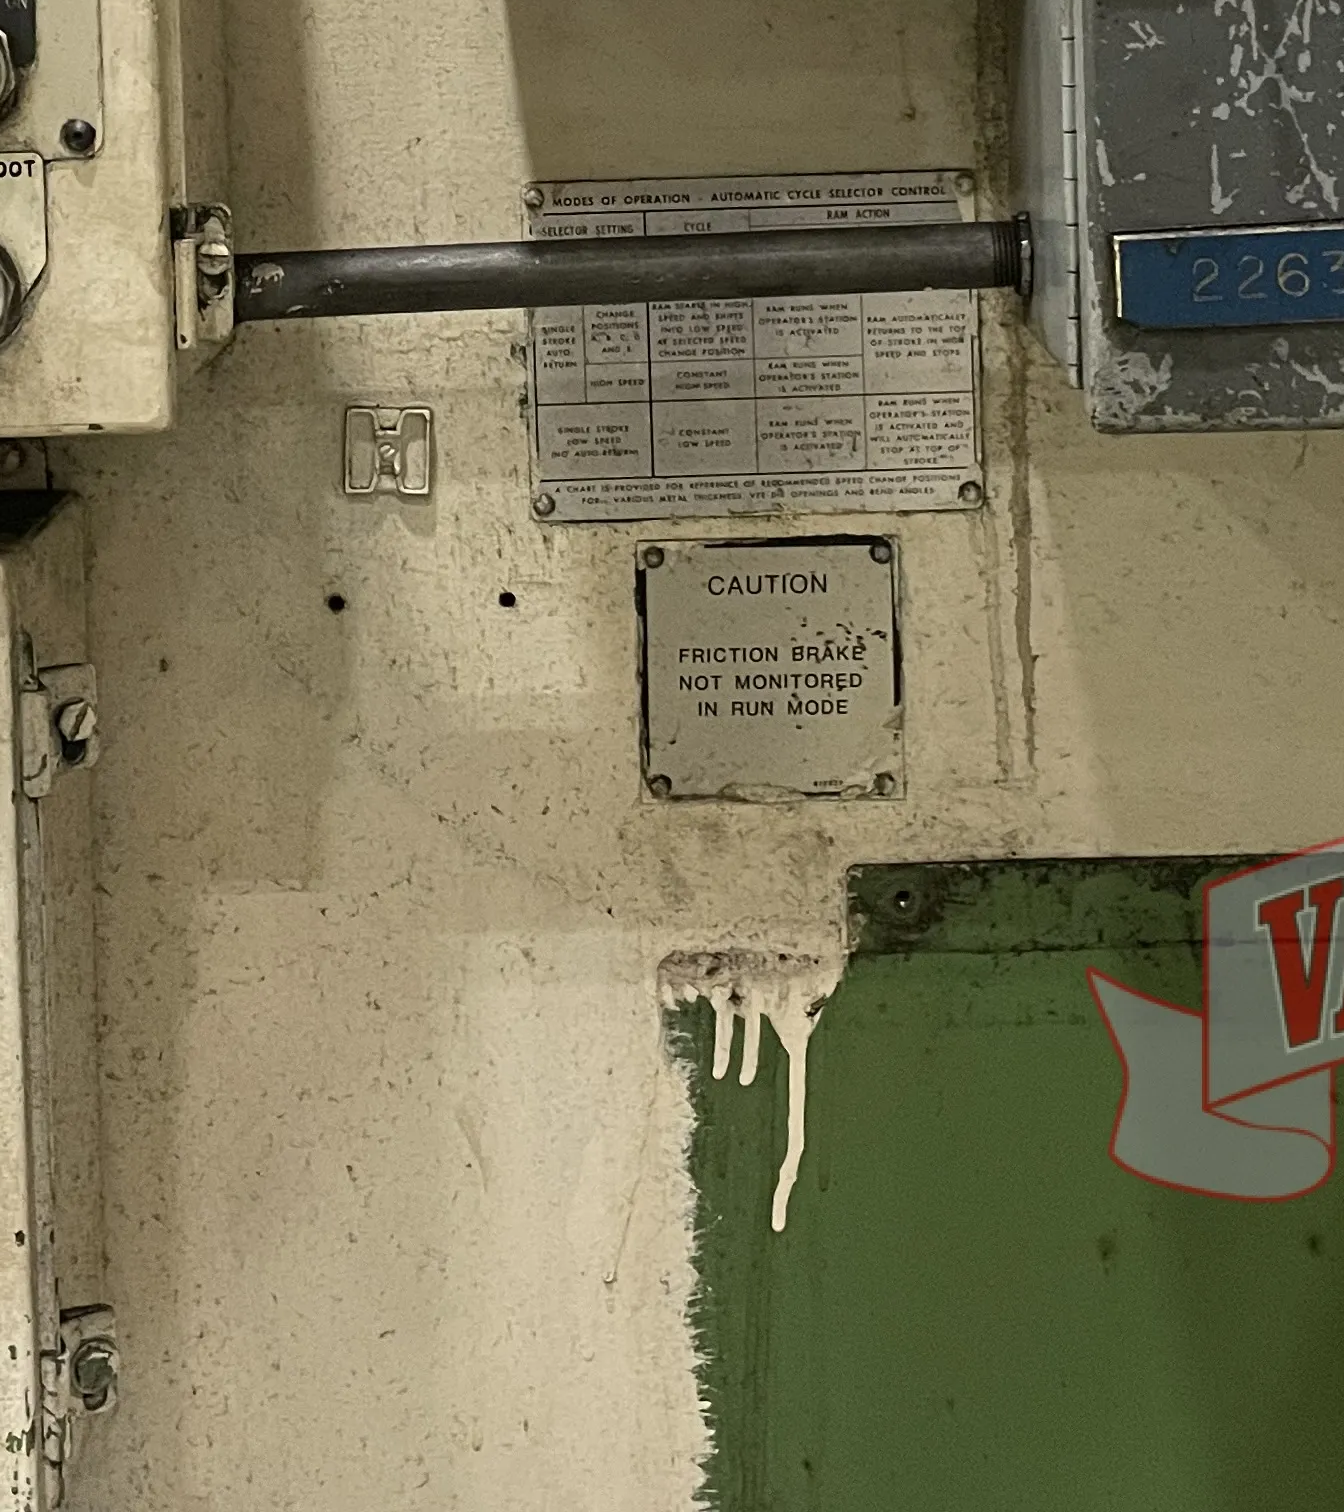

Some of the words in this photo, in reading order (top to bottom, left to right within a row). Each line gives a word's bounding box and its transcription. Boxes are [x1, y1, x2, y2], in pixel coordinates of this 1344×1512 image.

[552, 196, 594, 207] MODES
[601, 196, 616, 206] OF
[623, 193, 691, 205] OPERATION
[711, 189, 780, 202] AUTOMATIC
[787, 189, 822, 200] CYCLE
[828, 187, 883, 198] SELECTOR
[891, 186, 946, 196] CONTROL
[708, 574, 828, 596] CAUTION
[679, 647, 779, 663] FRICTION
[792, 645, 865, 662] BRAKE
[679, 675, 723, 691] NOT
[735, 673, 863, 690] MONITORED
[698, 701, 717, 717] IN
[731, 701, 774, 716] RUN
[787, 699, 848, 716] MODE
